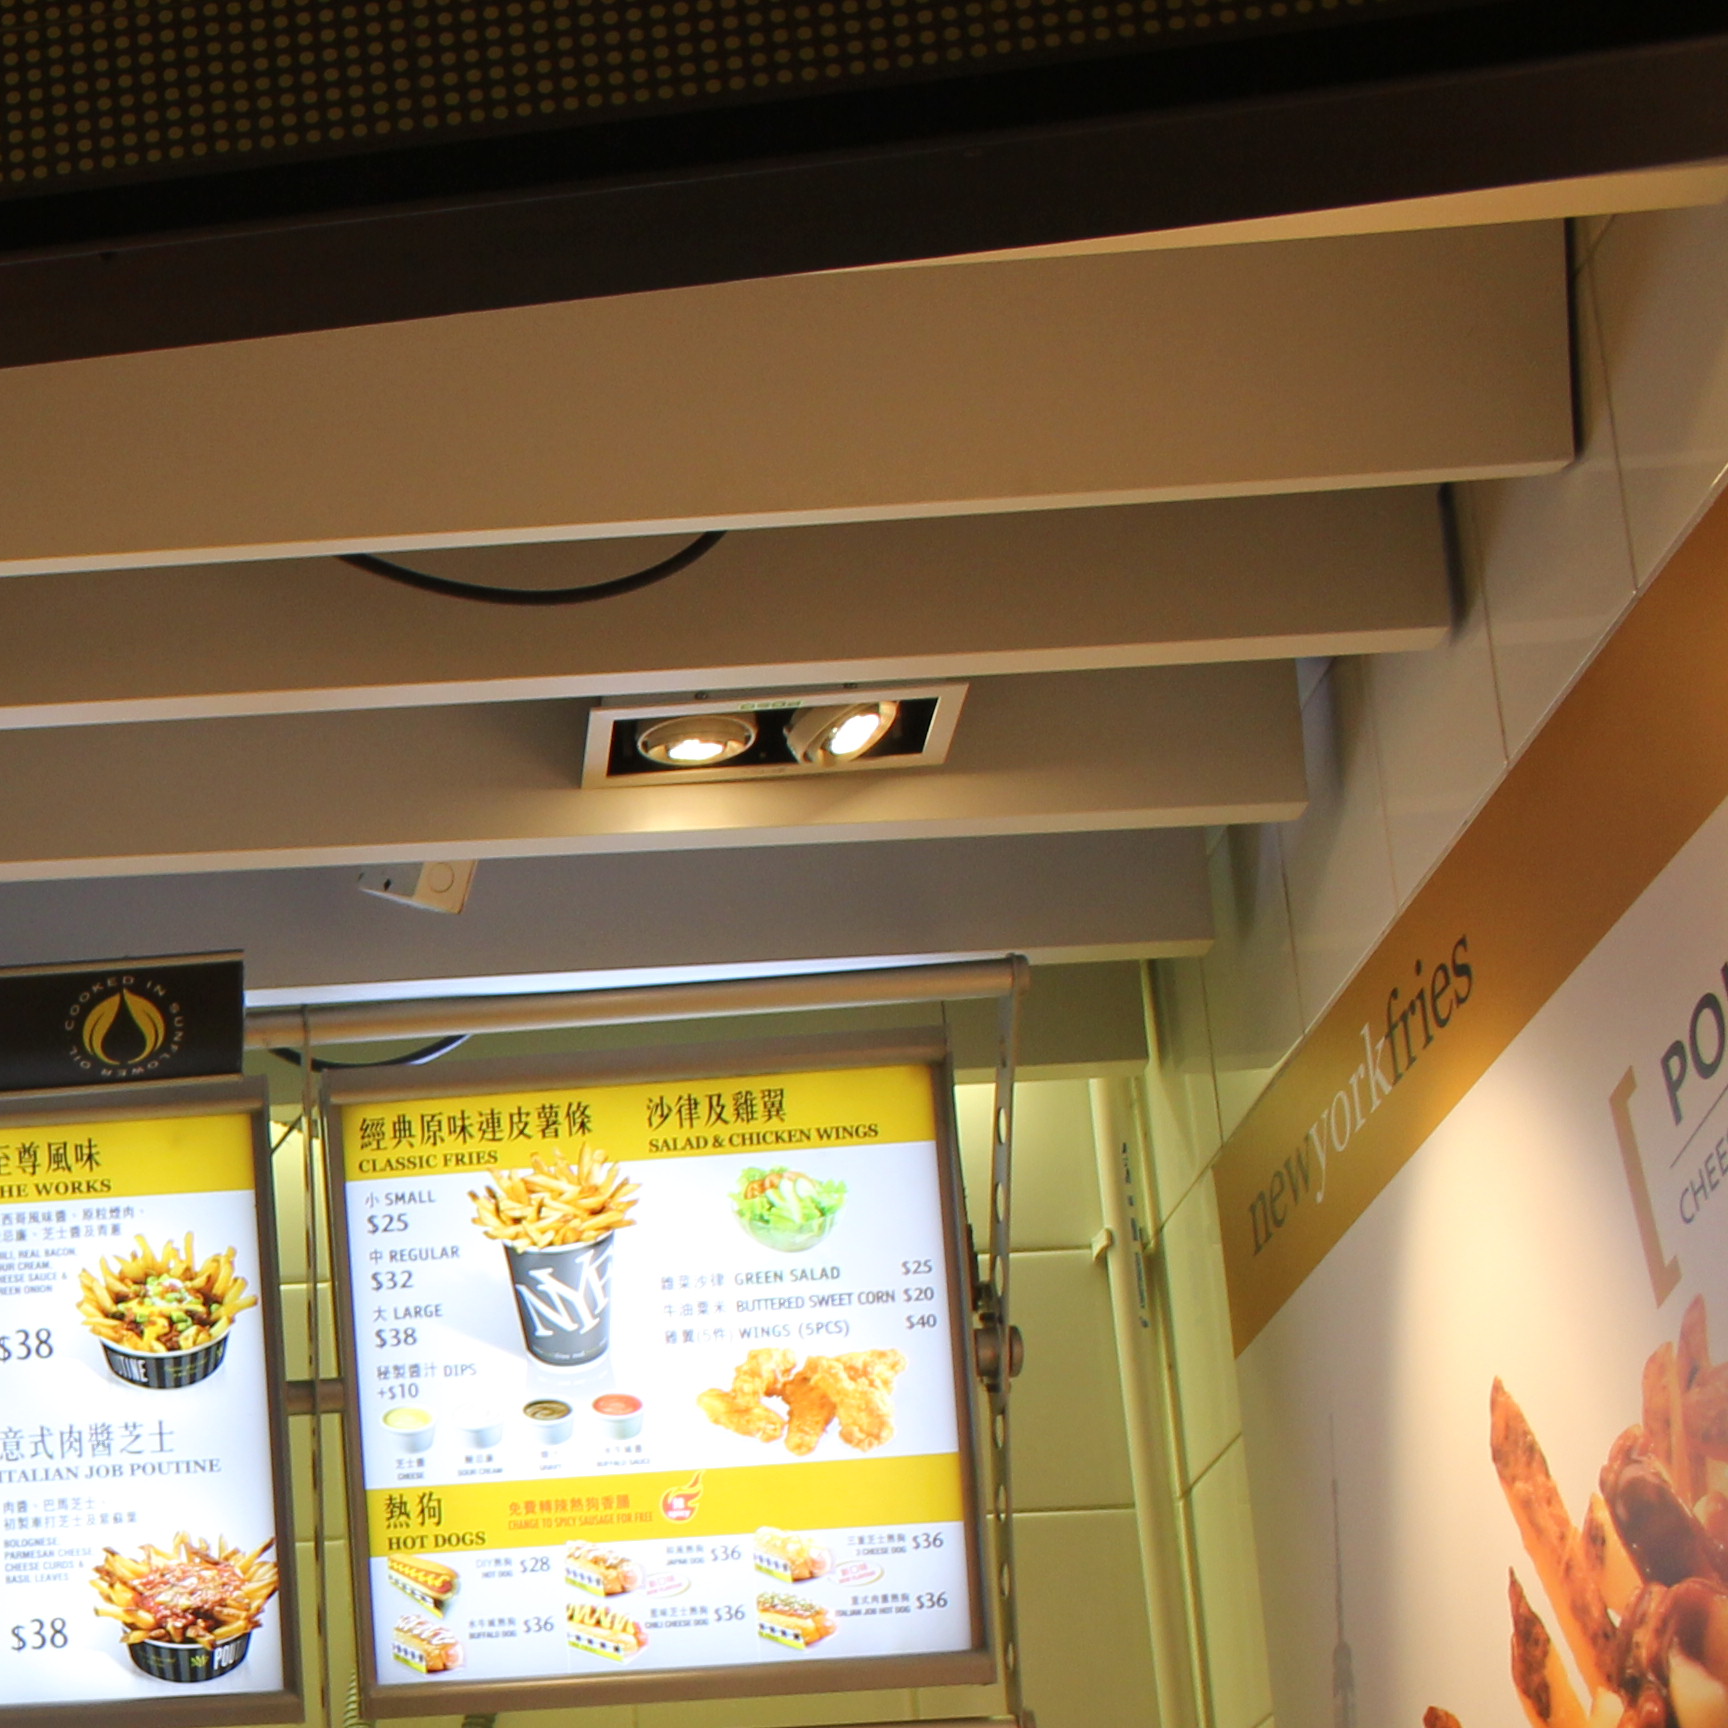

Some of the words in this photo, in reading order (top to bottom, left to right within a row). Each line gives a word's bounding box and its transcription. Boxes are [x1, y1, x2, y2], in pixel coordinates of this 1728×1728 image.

[146, 980, 166, 997] IN
[65, 976, 134, 1031] COOKED
[101, 1002, 184, 1077] SUNFLOWER
[69, 1045, 91, 1069] OIL
[646, 1088, 786, 1131] 沙律及雞翼
[359, 1101, 593, 1151] 經典原味連皮薯條
[649, 1134, 708, 1153] SALAD
[711, 1133, 726, 1149] &
[728, 1128, 812, 1148] CHICKEN
[816, 1123, 879, 1141] WINGS
[358, 1154, 438, 1174] CLASSIC
[443, 1150, 499, 1167] FRIES
[34, 1179, 112, 1196] WORKS
[365, 1194, 379, 1208] 小
[384, 1190, 436, 1206] SMALL
[367, 1213, 409, 1235] $25
[369, 1249, 384, 1265] 中
[389, 1245, 461, 1263] REGULAR
[371, 1270, 414, 1292] $32
[734, 1270, 784, 1286] GREEN
[790, 1266, 841, 1282] SALAD
[901, 1259, 932, 1276] $25
[736, 1296, 806, 1314] BUTTERED
[809, 1292, 854, 1309] SWEET
[857, 1290, 896, 1304] CORN
[903, 1287, 935, 1303] $20
[373, 1306, 387, 1322] 大
[394, 1304, 444, 1320] LARGE
[375, 1327, 418, 1349] $38
[738, 1324, 791, 1340] WINGS
[905, 1314, 938, 1330] $40
[444, 1363, 477, 1377] DIPS
[377, 1383, 419, 1401] +$10
[0, 1420, 175, 1462] 意式肉醬芝士
[85, 1464, 124, 1479] JOB
[129, 1458, 222, 1477] POUTINE
[385, 1491, 442, 1529] 熱狗
[387, 1534, 429, 1551] HOT
[433, 1531, 486, 1548] DOGS
[912, 1532, 944, 1550] $36
[711, 1545, 742, 1562] $36
[520, 1557, 551, 1574] $28
[916, 1592, 948, 1610] $36
[713, 1604, 745, 1623] $36
[11, 1618, 69, 1652] $38
[523, 1616, 554, 1634] $36
